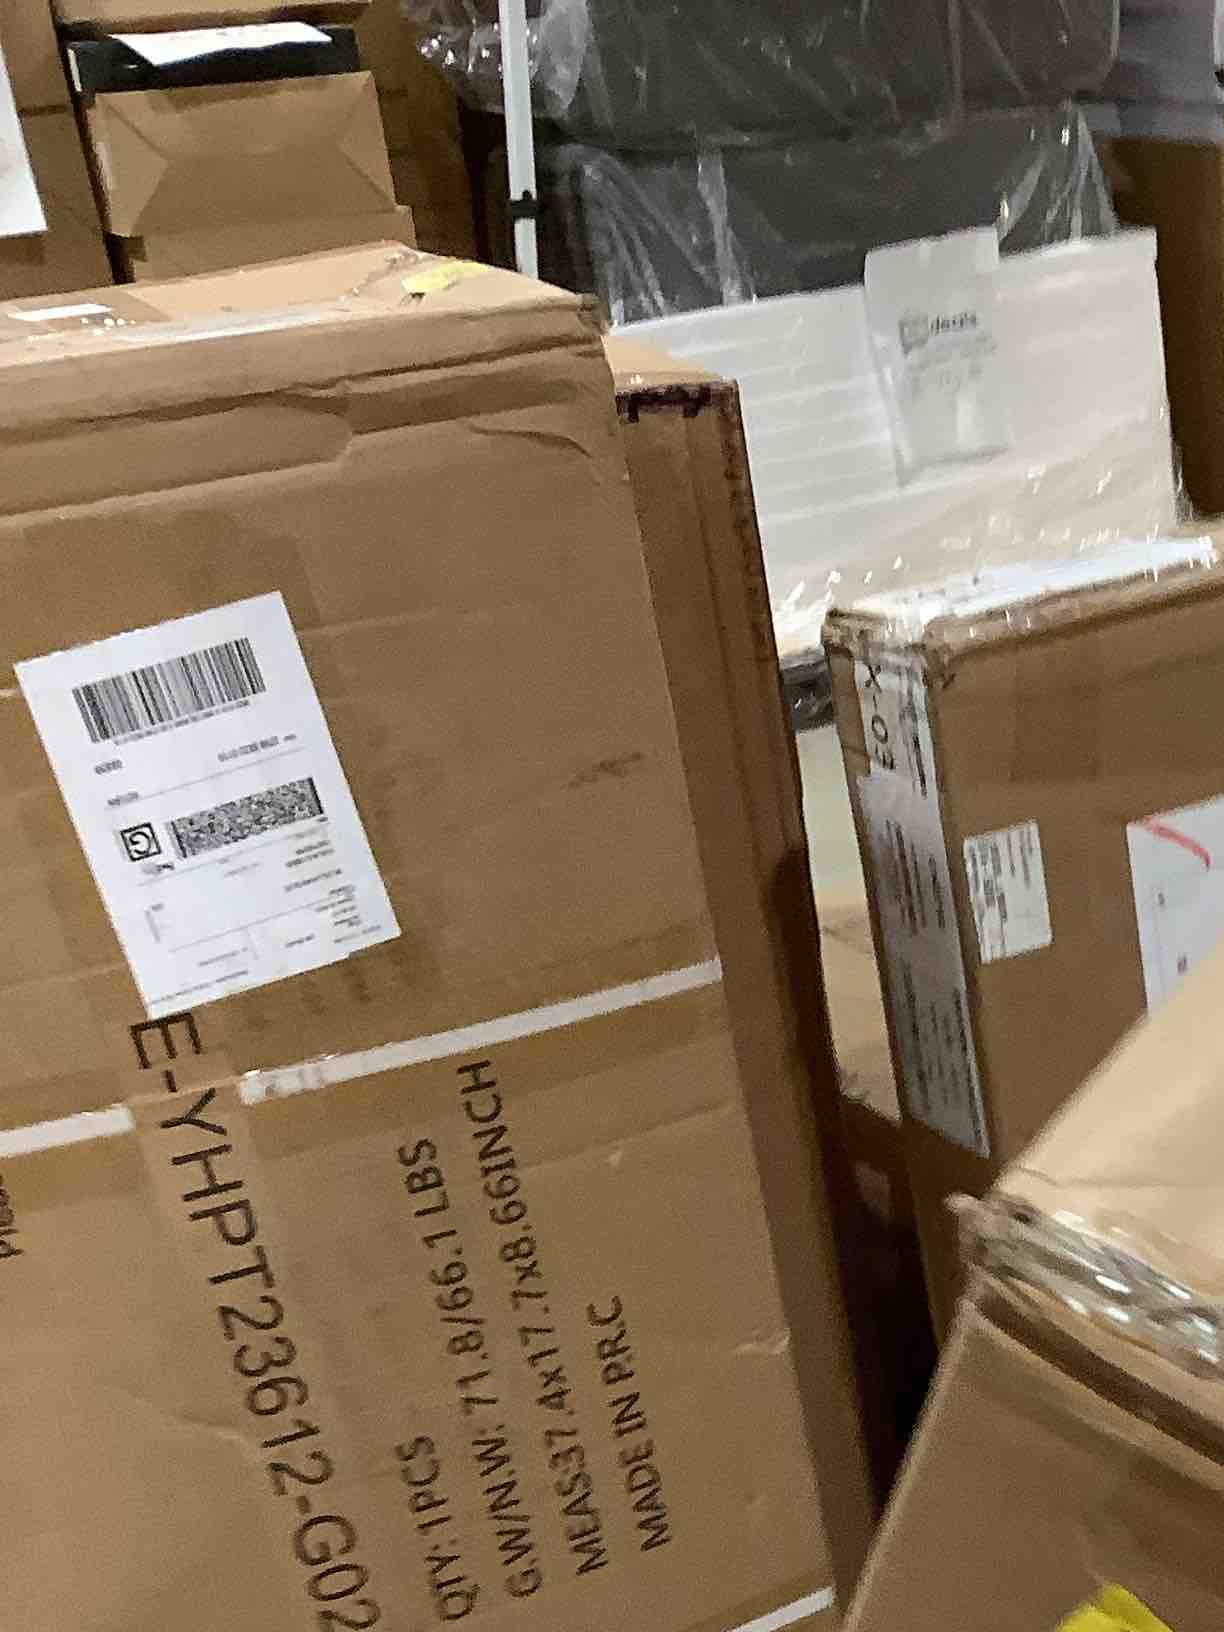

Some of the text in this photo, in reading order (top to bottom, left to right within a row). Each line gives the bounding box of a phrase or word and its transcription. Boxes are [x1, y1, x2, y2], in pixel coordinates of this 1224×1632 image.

[397, 1138, 451, 1219] LBS
[421, 1228, 500, 1417] 71.8/66.1
[608, 1391, 648, 1439] IN
[617, 1439, 673, 1552] MADE
